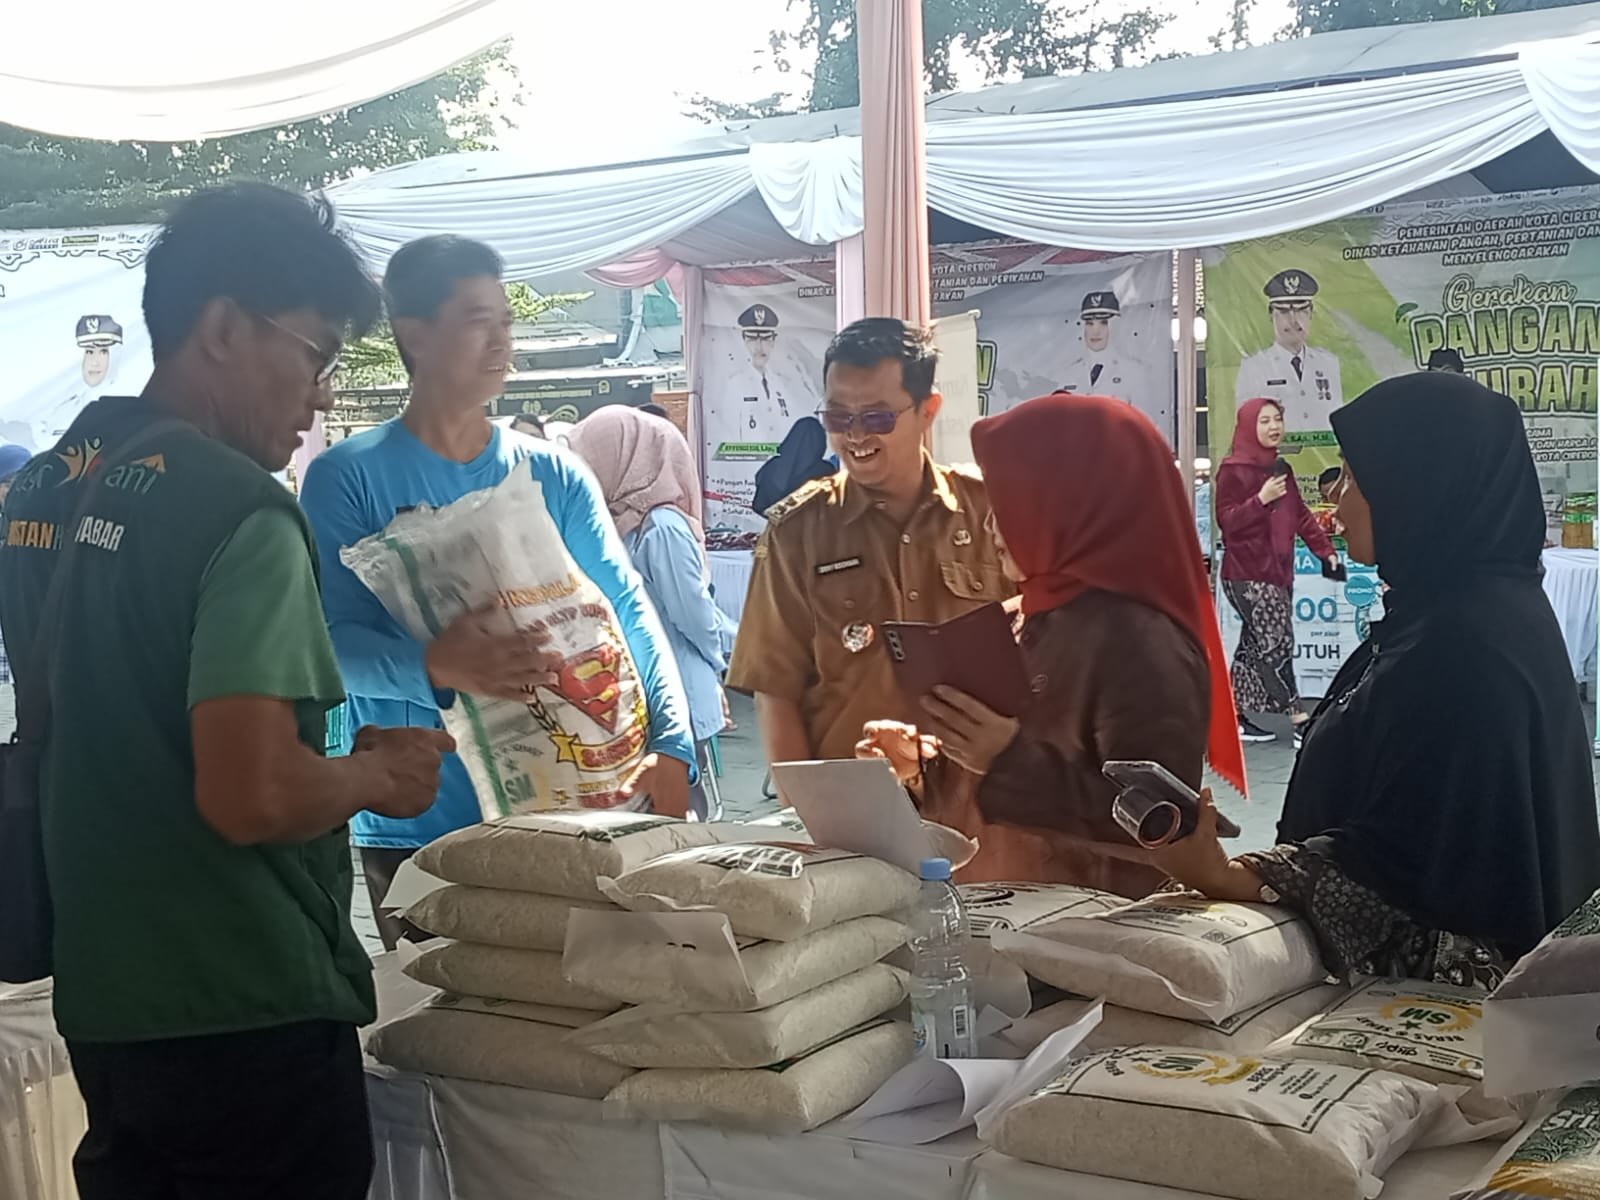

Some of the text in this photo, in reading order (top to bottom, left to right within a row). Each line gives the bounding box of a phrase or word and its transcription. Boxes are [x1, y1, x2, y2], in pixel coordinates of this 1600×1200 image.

[1398, 220, 1473, 240] PEMERINTAH
[1475, 216, 1523, 232] DAERAH
[1526, 212, 1558, 228] KOTA
[1343, 246, 1378, 261] DINAS
[1379, 240, 1449, 257] KETAHANAN
[1506, 228, 1574, 245] PERTANIAN
[1442, 243, 1570, 267] MENYELENGGARAKAN
[933, 271, 1045, 289] TANIAN DAN PERIKANAN
[957, 261, 998, 273] CIREBON
[1446, 277, 1572, 313] Gerakan
[1412, 303, 1600, 367] PANGAN
[1464, 364, 1597, 413] URAH
[1562, 450, 1597, 461] CIREBO
[1398, 1007, 1452, 1025] SM
